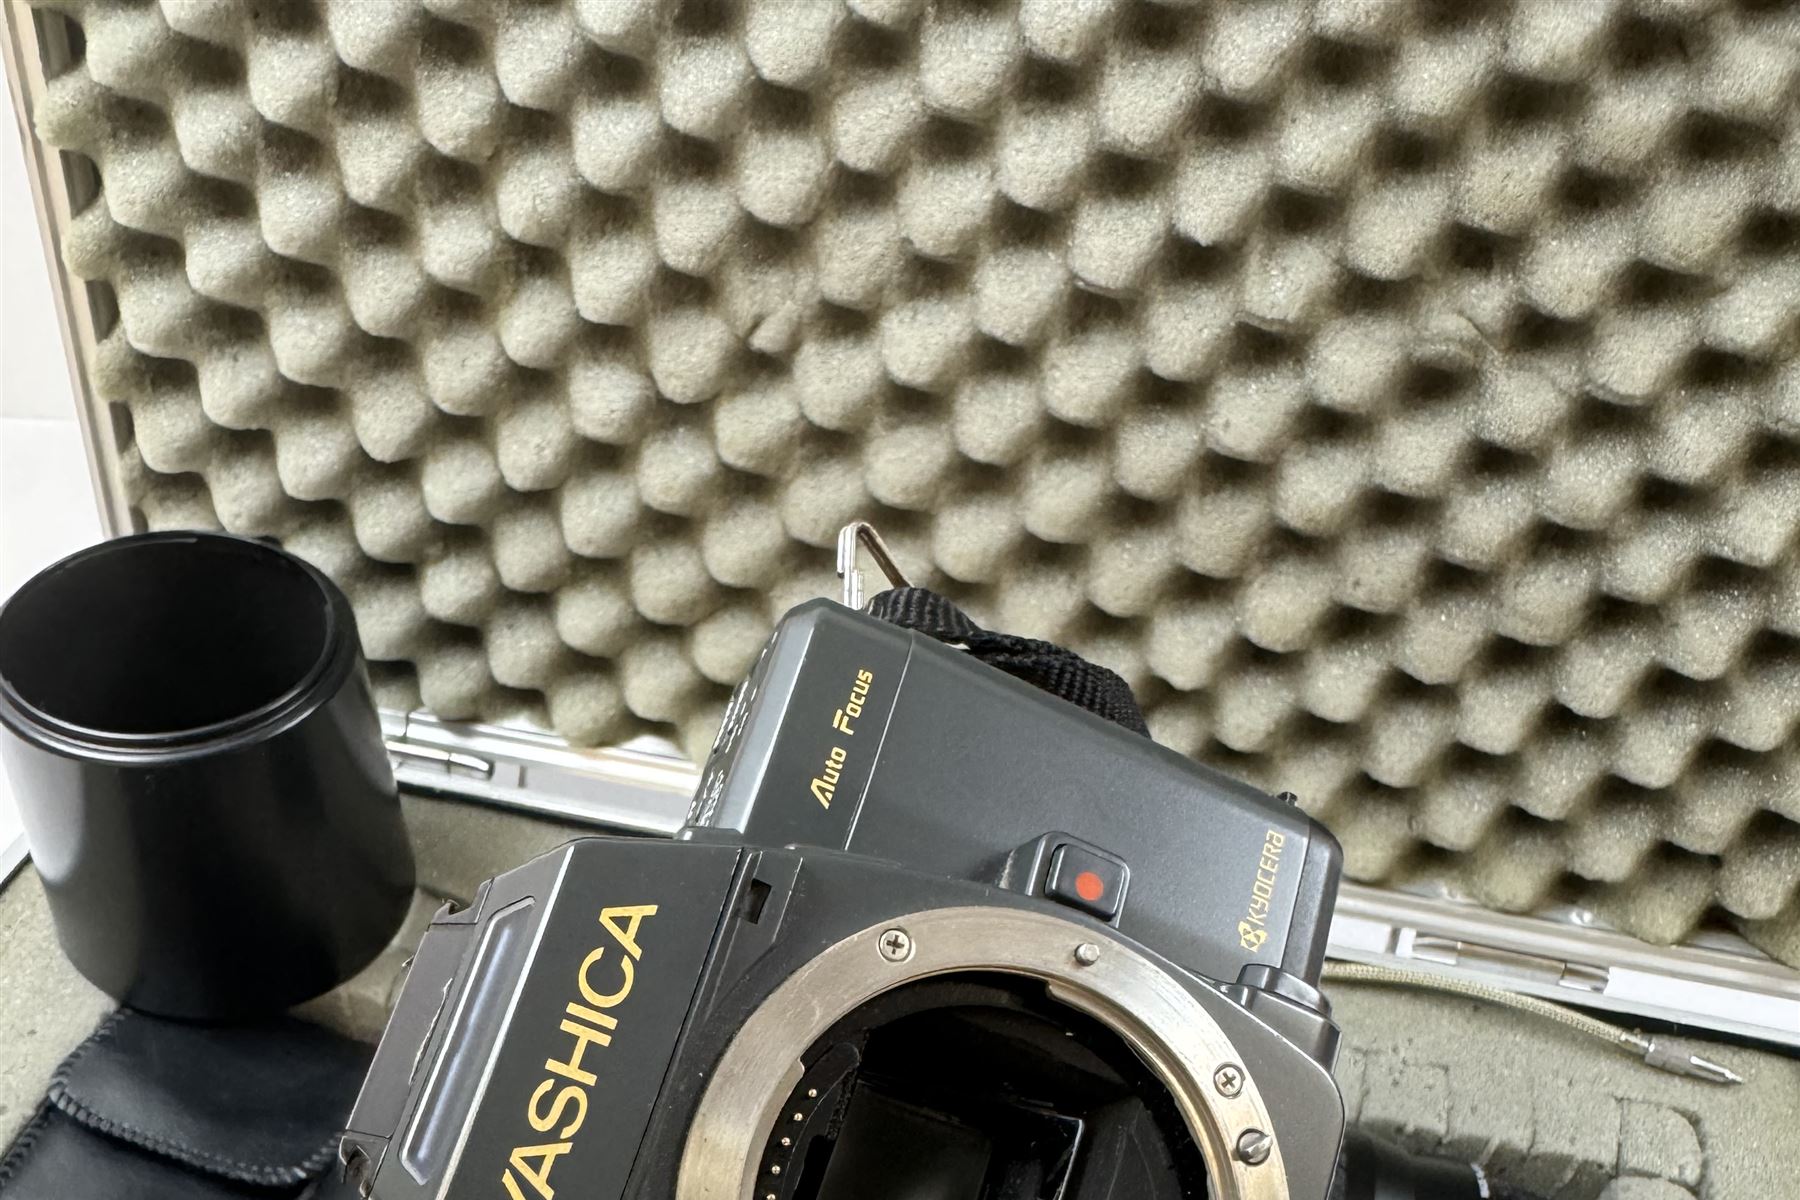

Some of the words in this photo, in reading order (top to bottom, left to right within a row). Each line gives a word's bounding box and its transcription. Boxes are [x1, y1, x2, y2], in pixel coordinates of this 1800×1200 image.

[810, 746, 847, 809] Auto
[832, 668, 873, 736] Focus
[1246, 829, 1286, 926] KYOCERA
